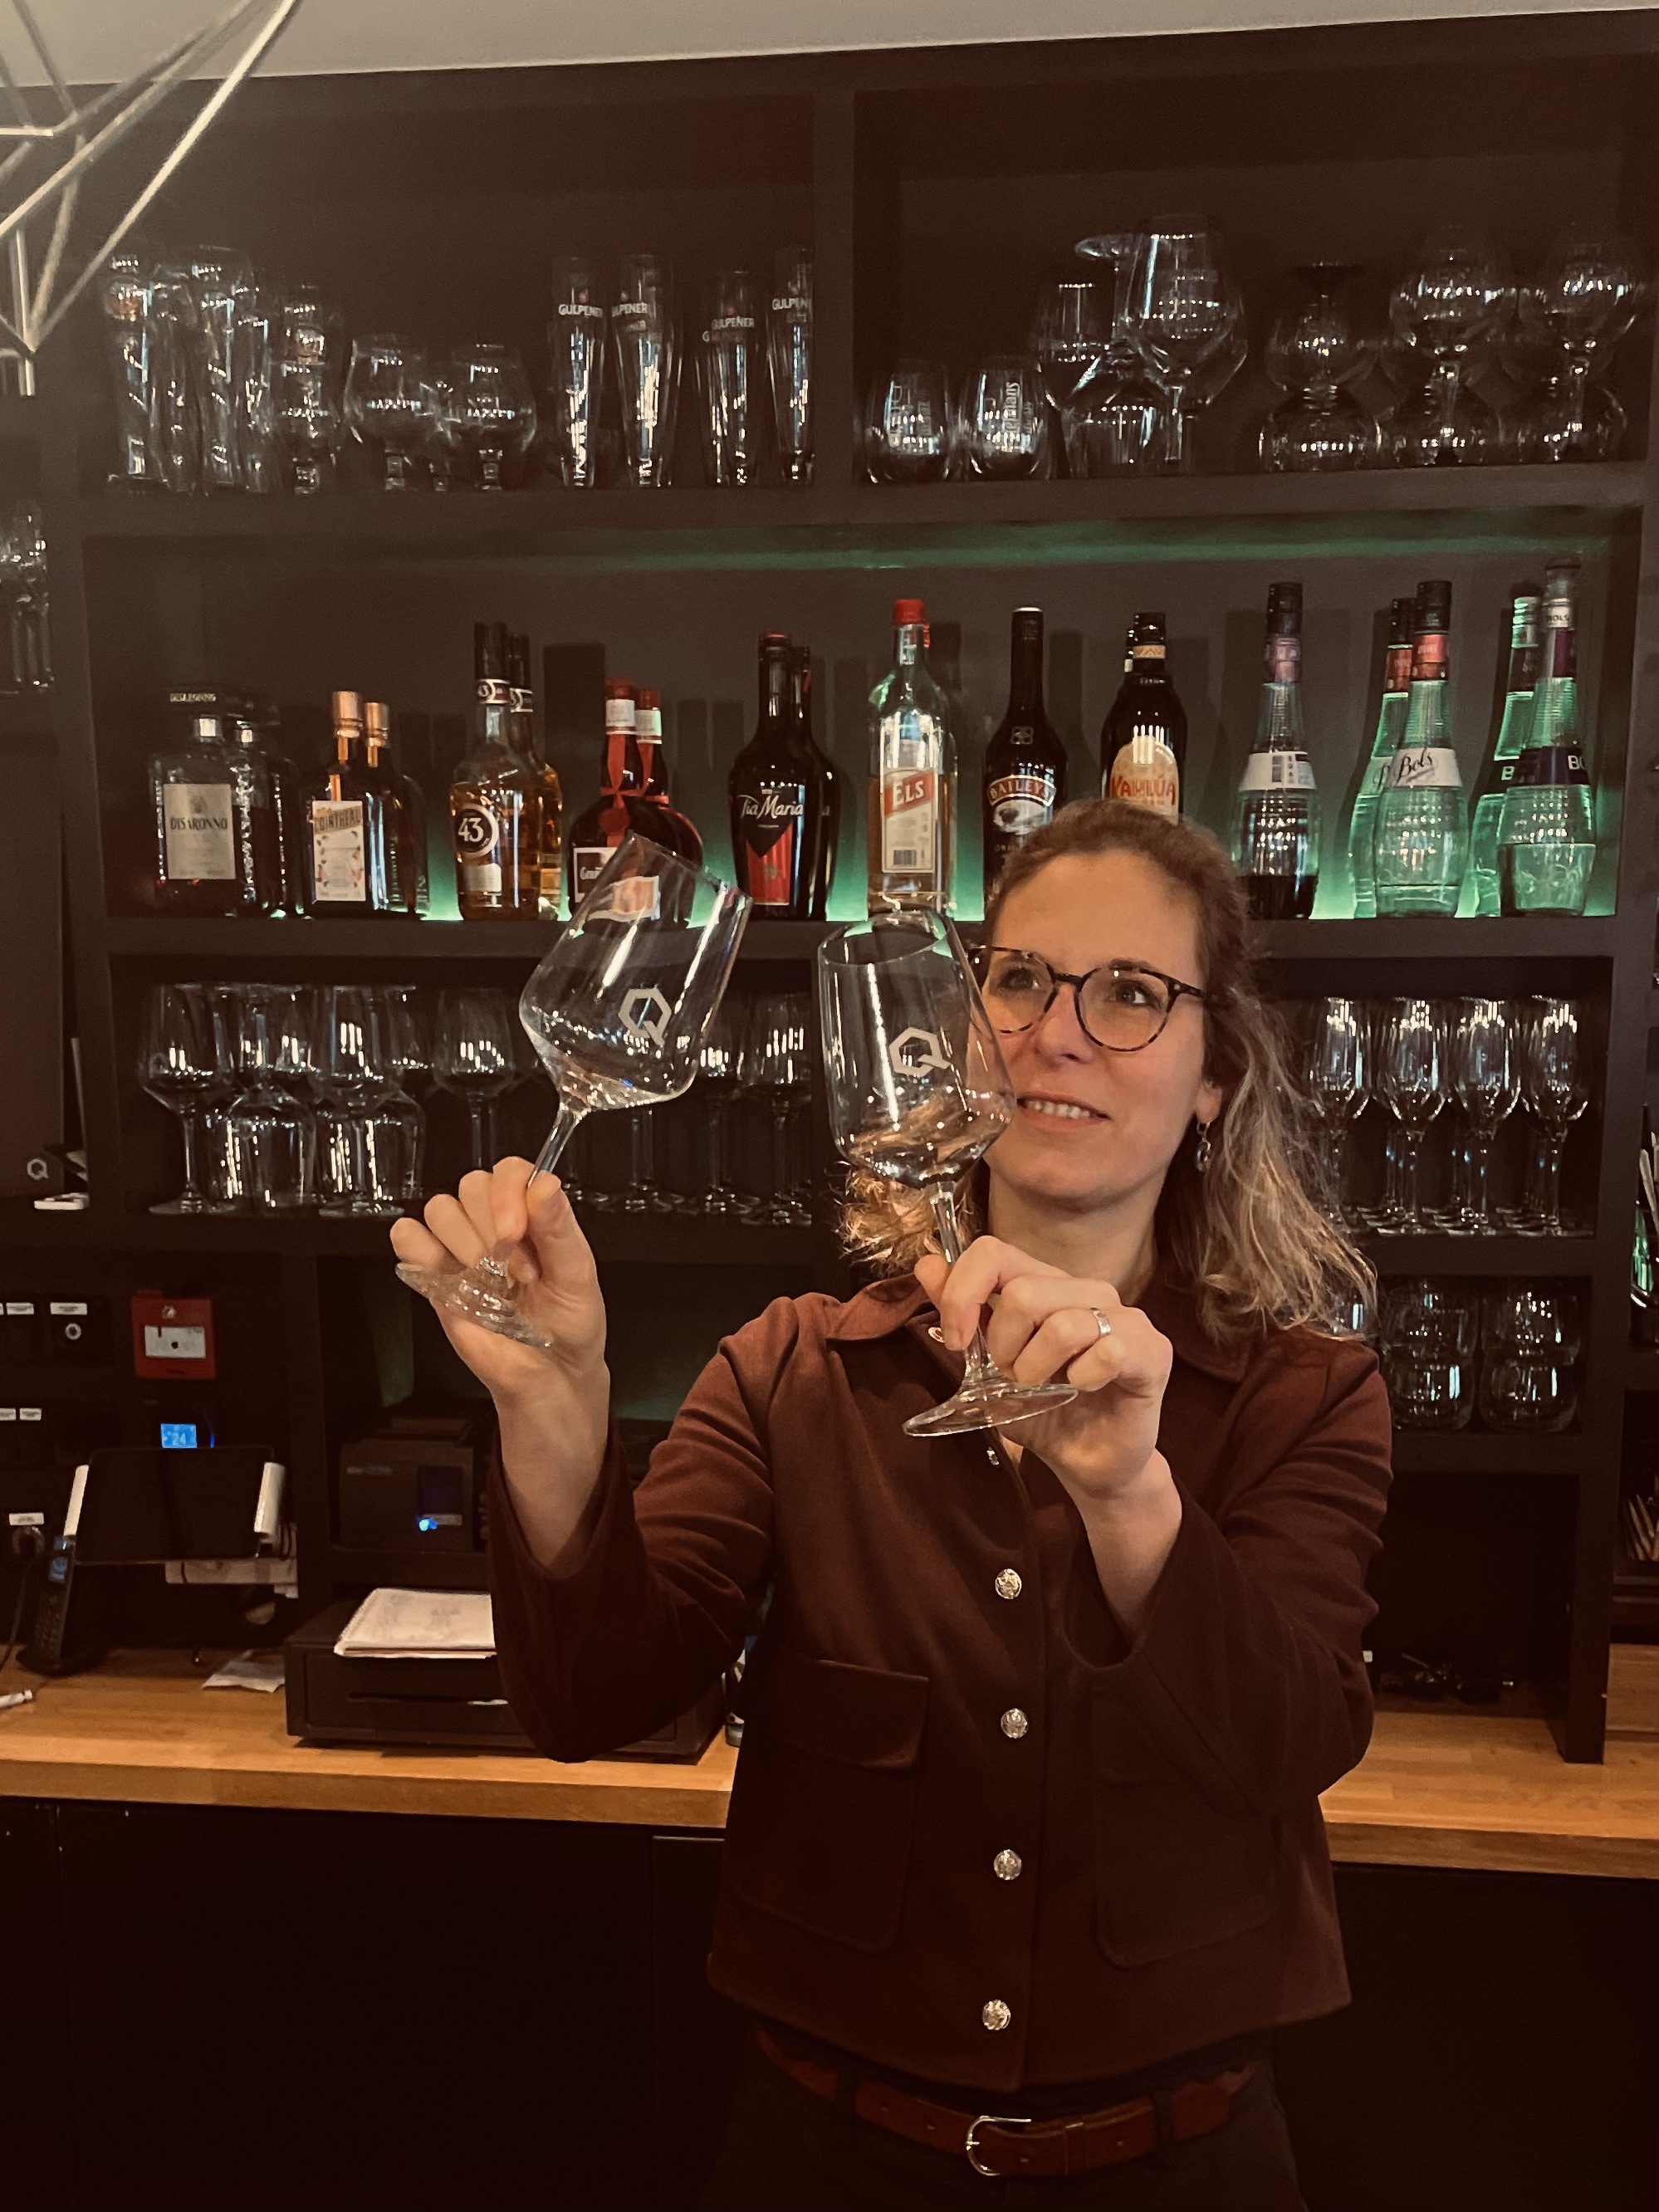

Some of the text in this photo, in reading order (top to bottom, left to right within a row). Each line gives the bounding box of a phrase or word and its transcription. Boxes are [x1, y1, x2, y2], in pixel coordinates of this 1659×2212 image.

[1397, 746, 1433, 784] Bols
[893, 780, 925, 807] ELS
[737, 794, 760, 819] Tia
[756, 795, 805, 820] Maria
[170, 816, 228, 830] DISARONNO
[458, 817, 484, 843] 43
[618, 987, 672, 1047] Q
[888, 1026, 952, 1077] Q
[27, 1157, 49, 1180] Q
